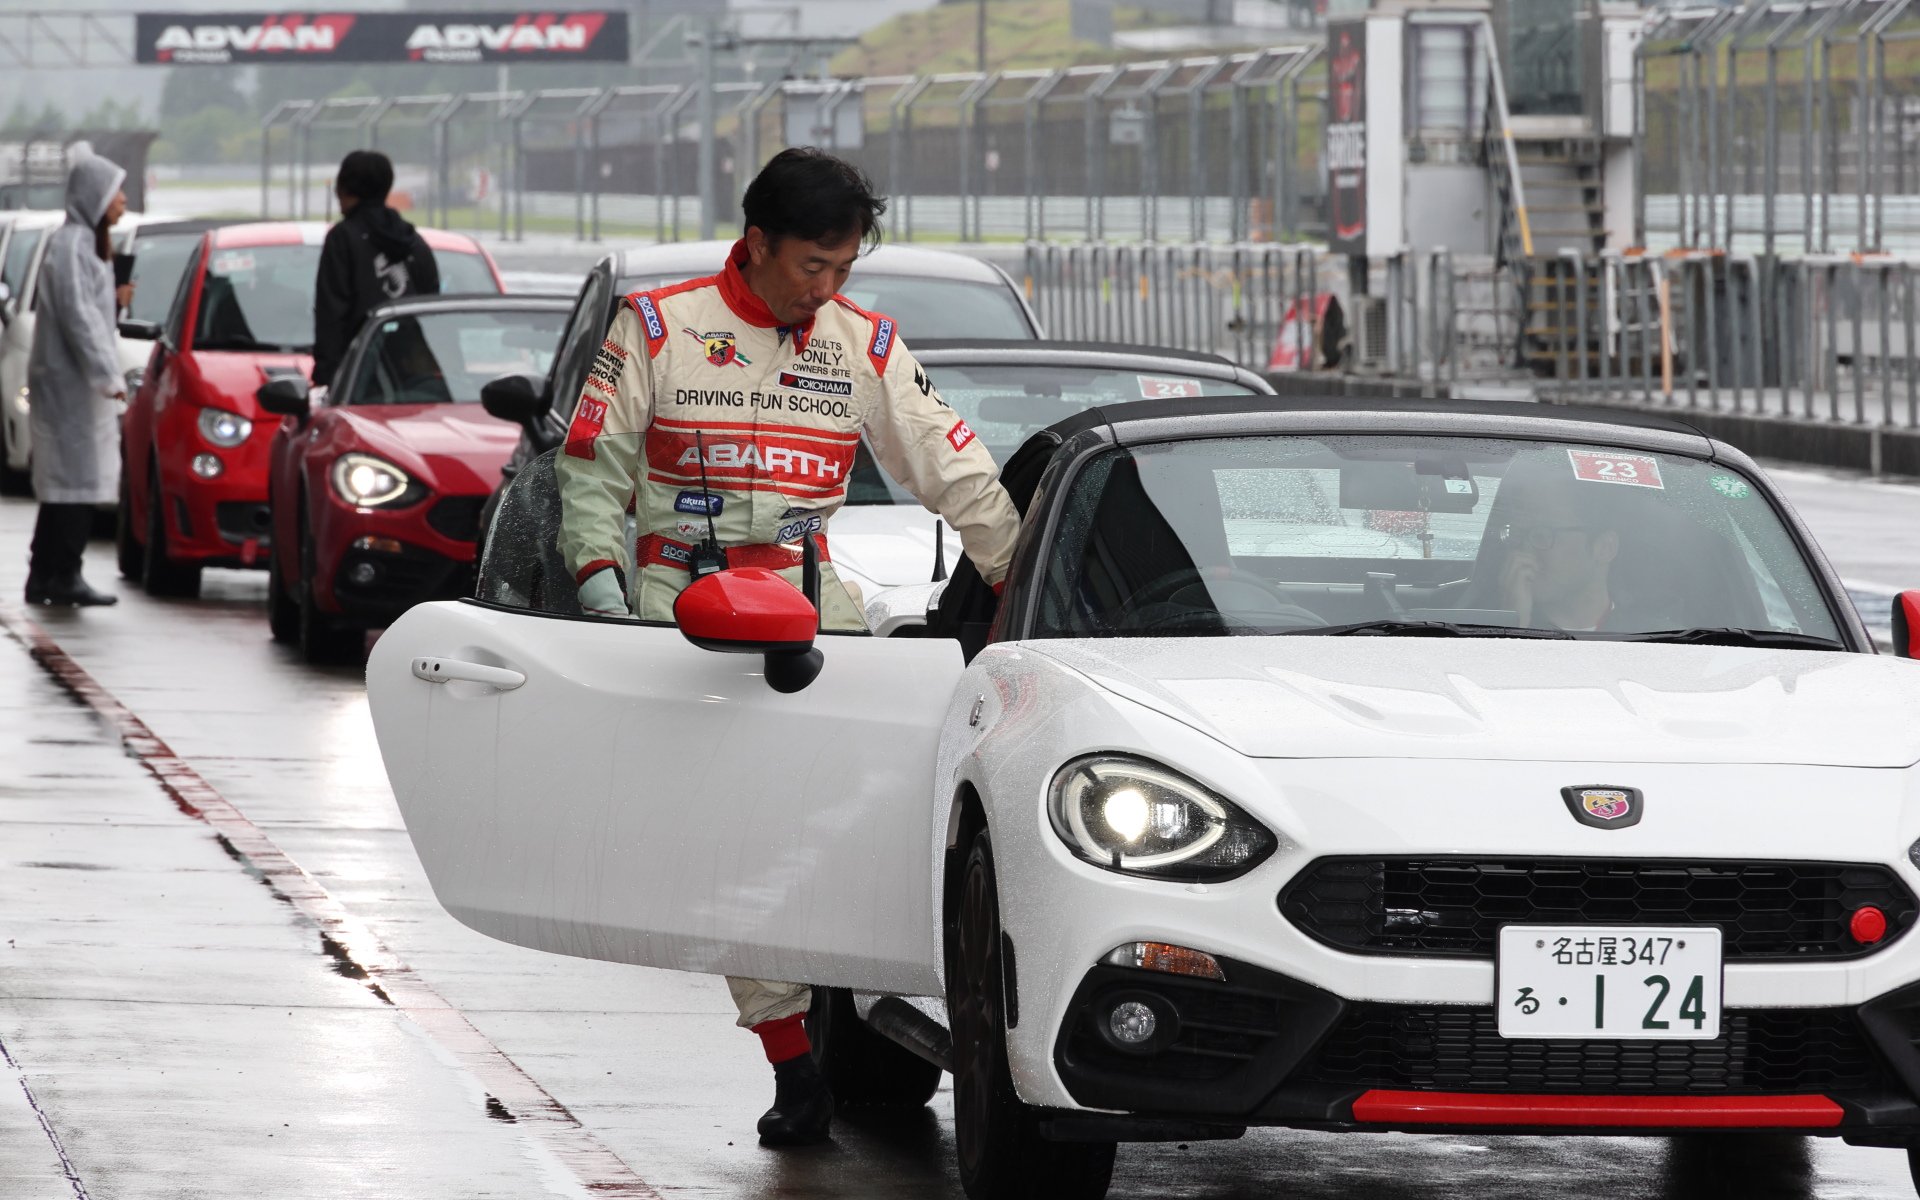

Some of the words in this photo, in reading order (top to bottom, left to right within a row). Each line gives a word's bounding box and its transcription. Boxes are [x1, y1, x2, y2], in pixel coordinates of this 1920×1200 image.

[155, 25, 335, 50] ADVAN
[405, 24, 586, 49] ADVAN
[637, 296, 662, 337] sparco
[806, 338, 842, 350] DULTS
[873, 319, 891, 356] sparco
[801, 349, 843, 366] ONLY
[792, 363, 829, 376] OWNERS
[831, 368, 851, 378] SITE
[797, 378, 850, 394] YOKOHAMA
[1156, 383, 1187, 396] 24
[676, 389, 744, 407] DRIVING
[750, 392, 782, 410] FUN
[788, 395, 852, 418] SCHOOL
[676, 443, 840, 479] ABARTH
[1595, 460, 1638, 478] 23
[774, 515, 821, 543] RAYS
